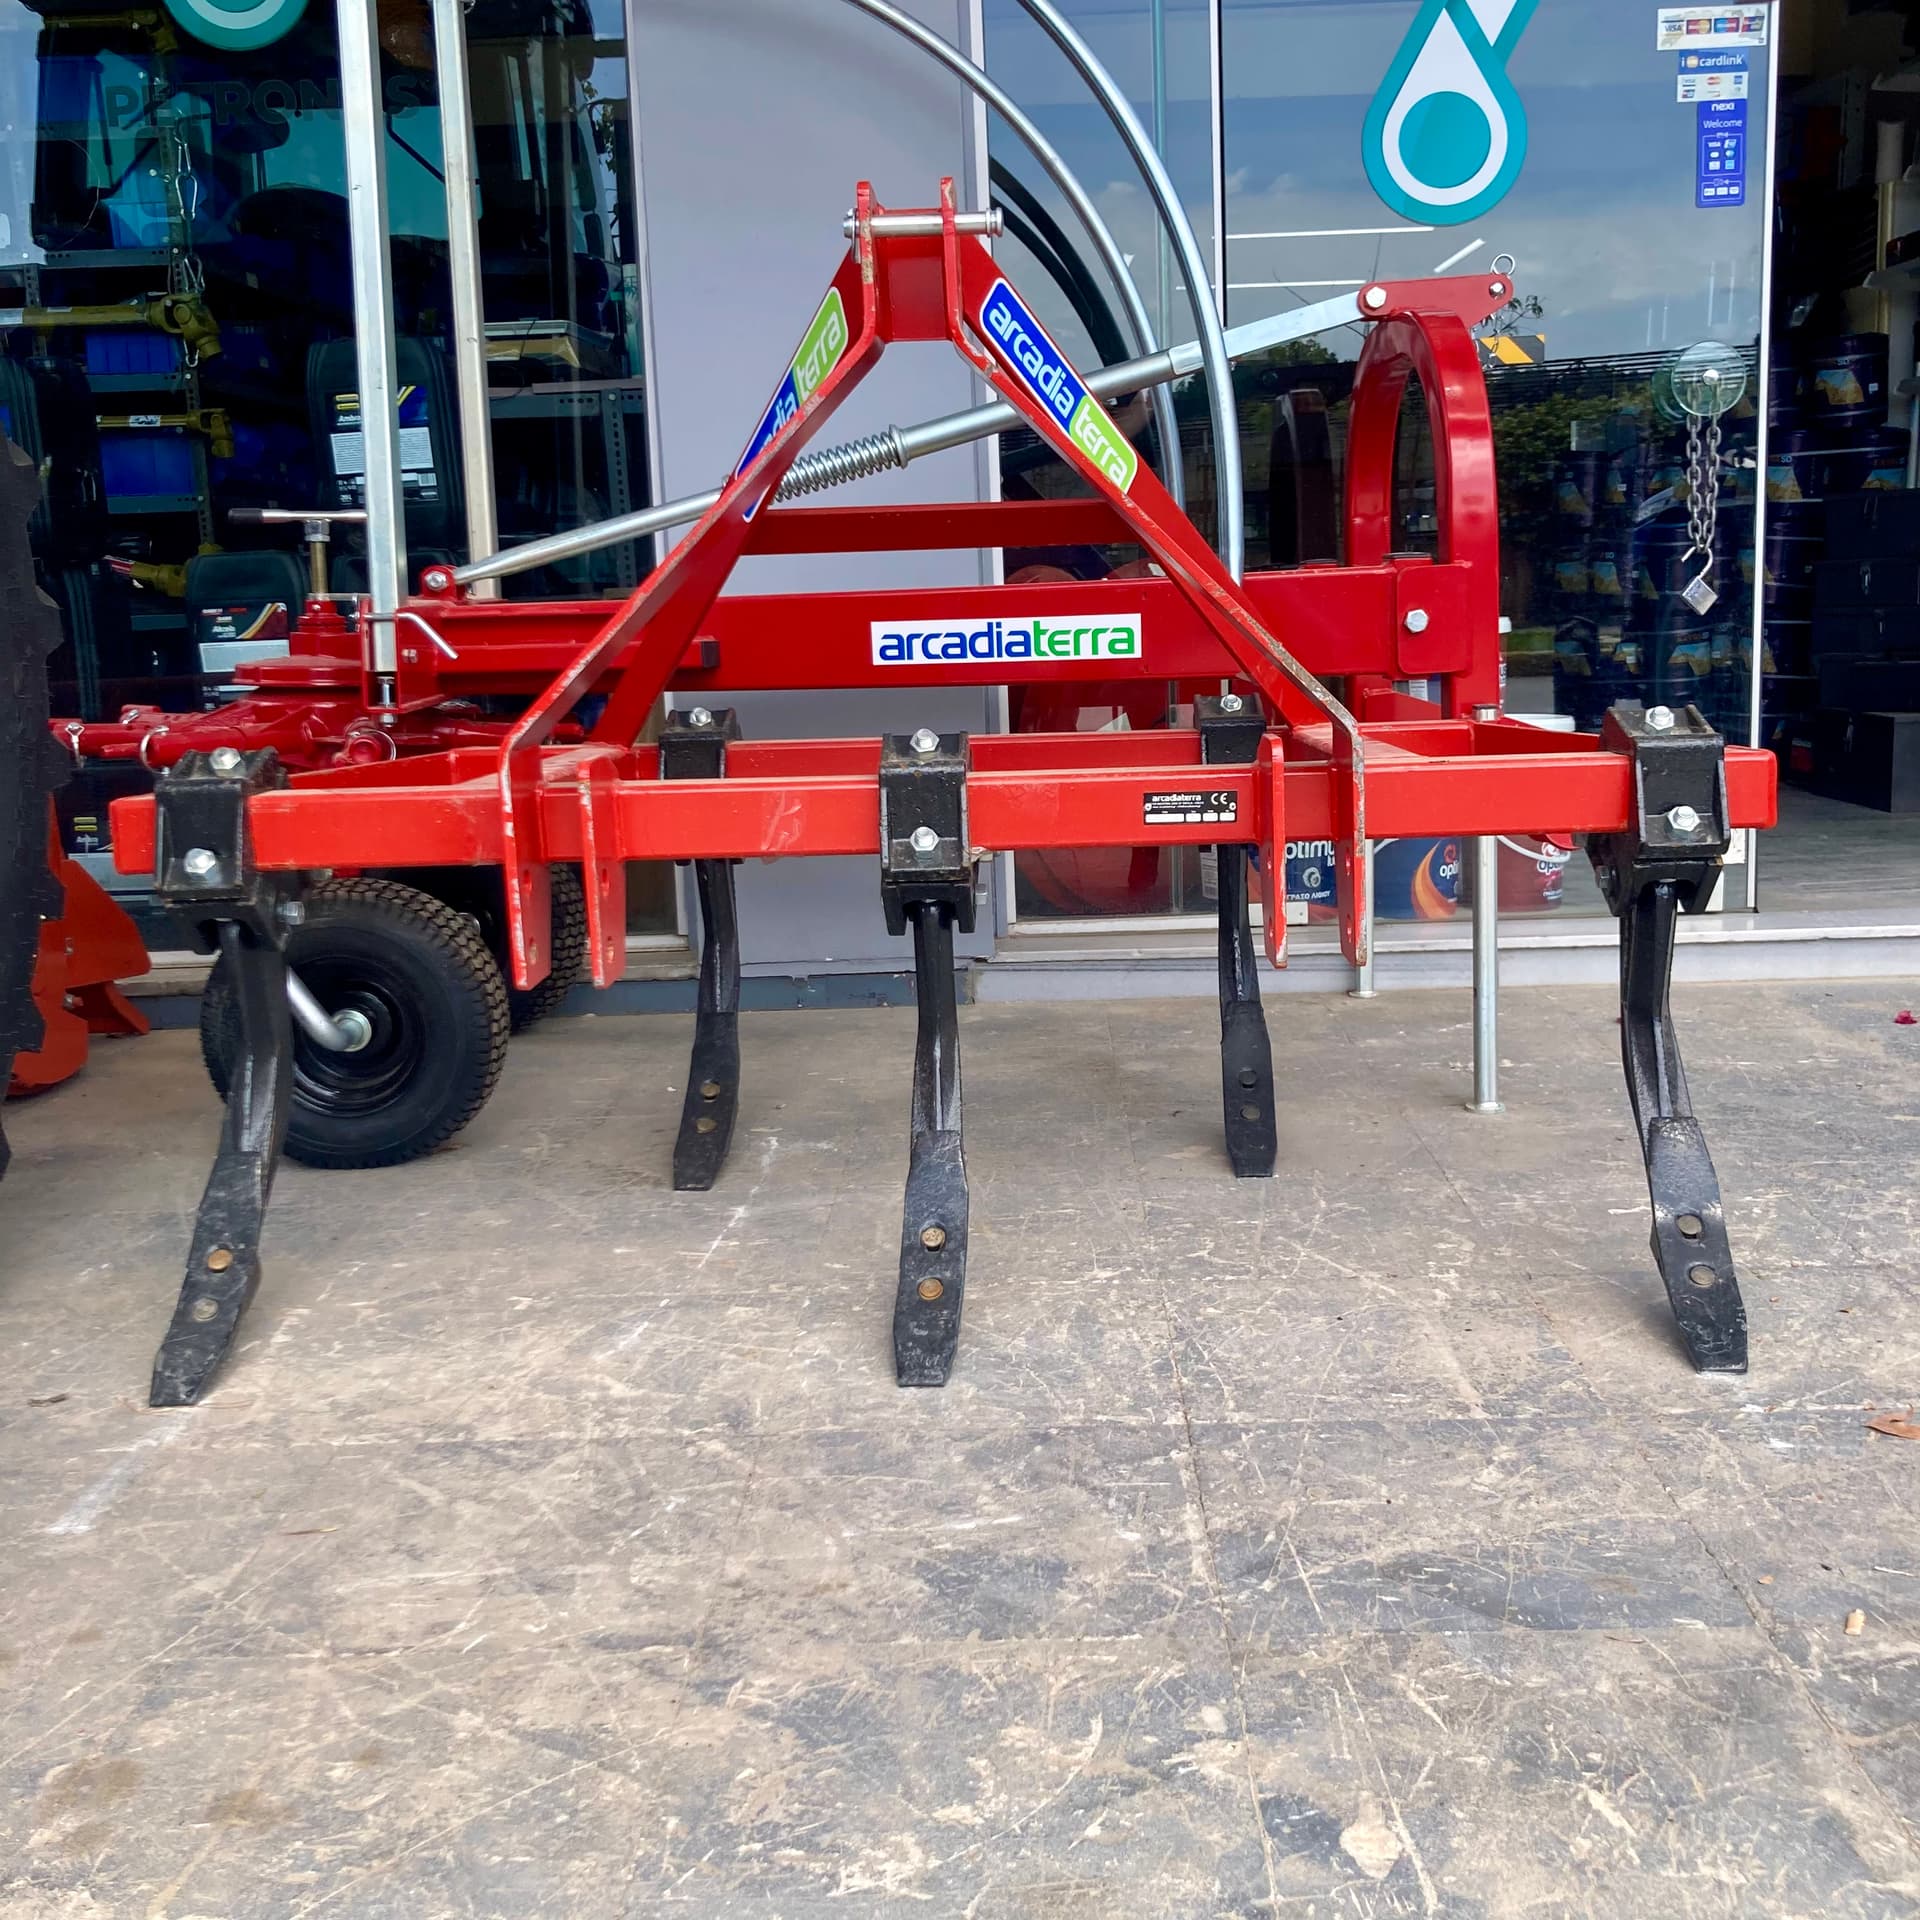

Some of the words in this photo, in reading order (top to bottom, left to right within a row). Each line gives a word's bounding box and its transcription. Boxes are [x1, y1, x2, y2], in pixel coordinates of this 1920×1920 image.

[1700, 55, 1744, 67] cardlink
[1703, 118, 1743, 128] Welcome
[879, 621, 1135, 661] arcadiaterra
[1152, 794, 1201, 802] arcadiaterra
